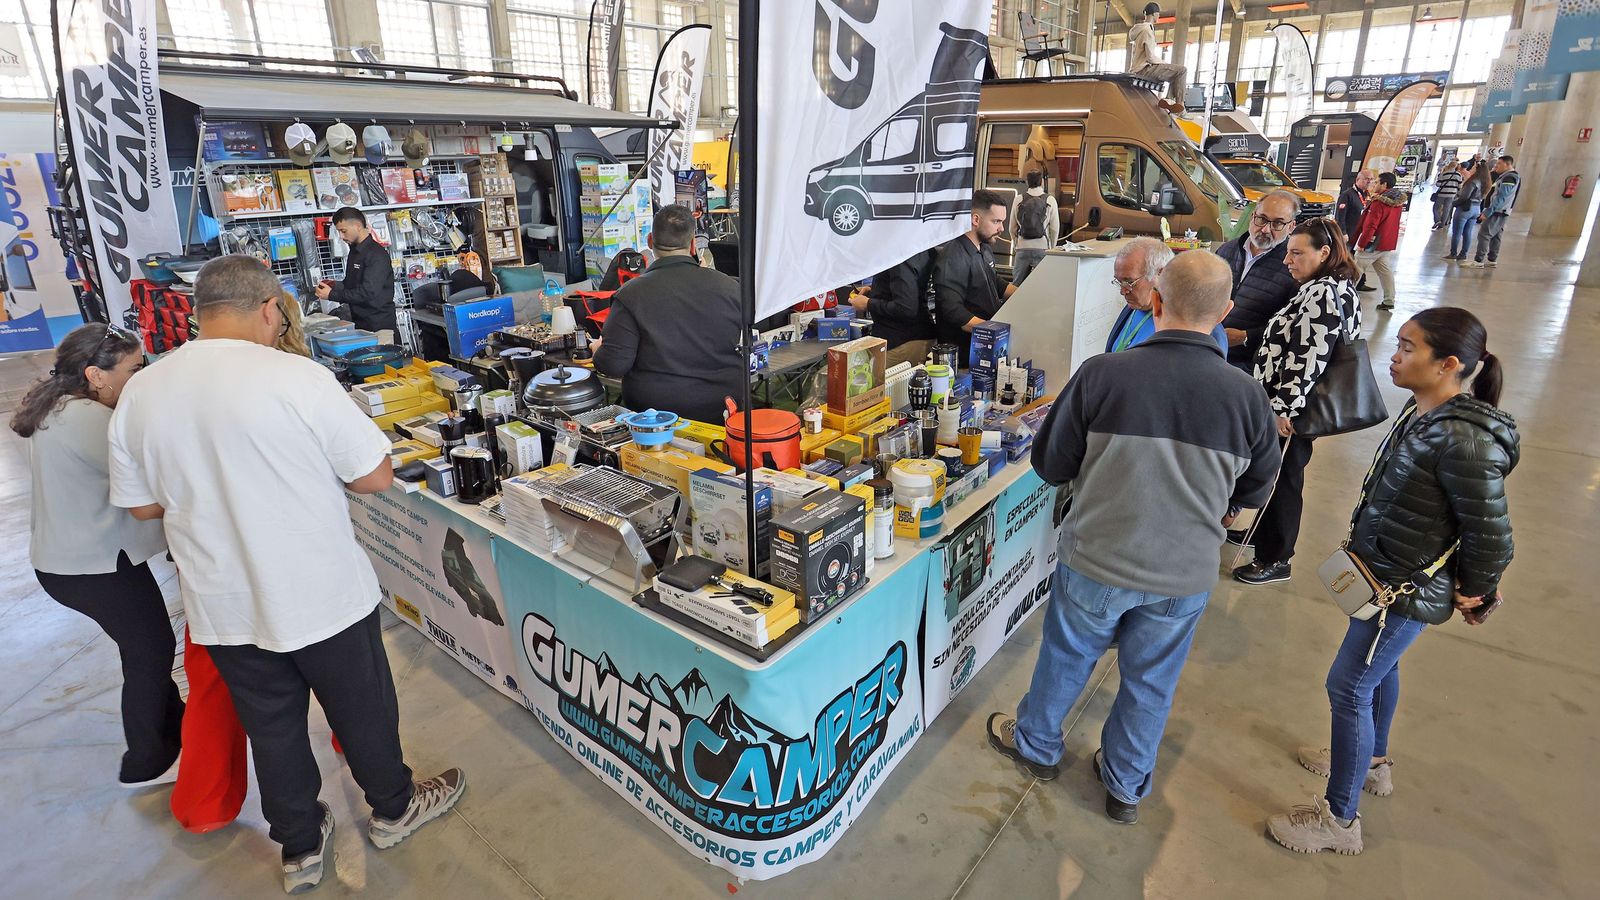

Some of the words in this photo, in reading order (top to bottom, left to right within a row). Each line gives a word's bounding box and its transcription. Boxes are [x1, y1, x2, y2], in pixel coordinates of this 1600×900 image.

[104, 0, 150, 213] CAMPE
[1229, 134, 1249, 147] sarch
[72, 67, 131, 284] GUMER
[468, 307, 501, 320] Nordkapp
[692, 479, 715, 491] MELAMIN
[1006, 481, 1051, 524] ESPECIALIST
[424, 582, 456, 609] ELEVABLES
[671, 600, 684, 610] TOAST
[684, 604, 704, 619] SANDWICH
[704, 615, 719, 627] MAKER
[426, 619, 457, 652] THULE
[931, 645, 951, 670] SIN
[951, 602, 991, 655] NECESIDAD
[460, 646, 496, 676] THETFORD
[522, 693, 535, 713] TU
[535, 706, 574, 749] TIENDA
[577, 741, 624, 785] ONLINE
[625, 776, 643, 802] DE
[645, 796, 758, 868] ACCESORIOS
[763, 815, 842, 867] CAMPER
[844, 797, 855, 819] Y
[855, 713, 921, 804] CARAVANING
